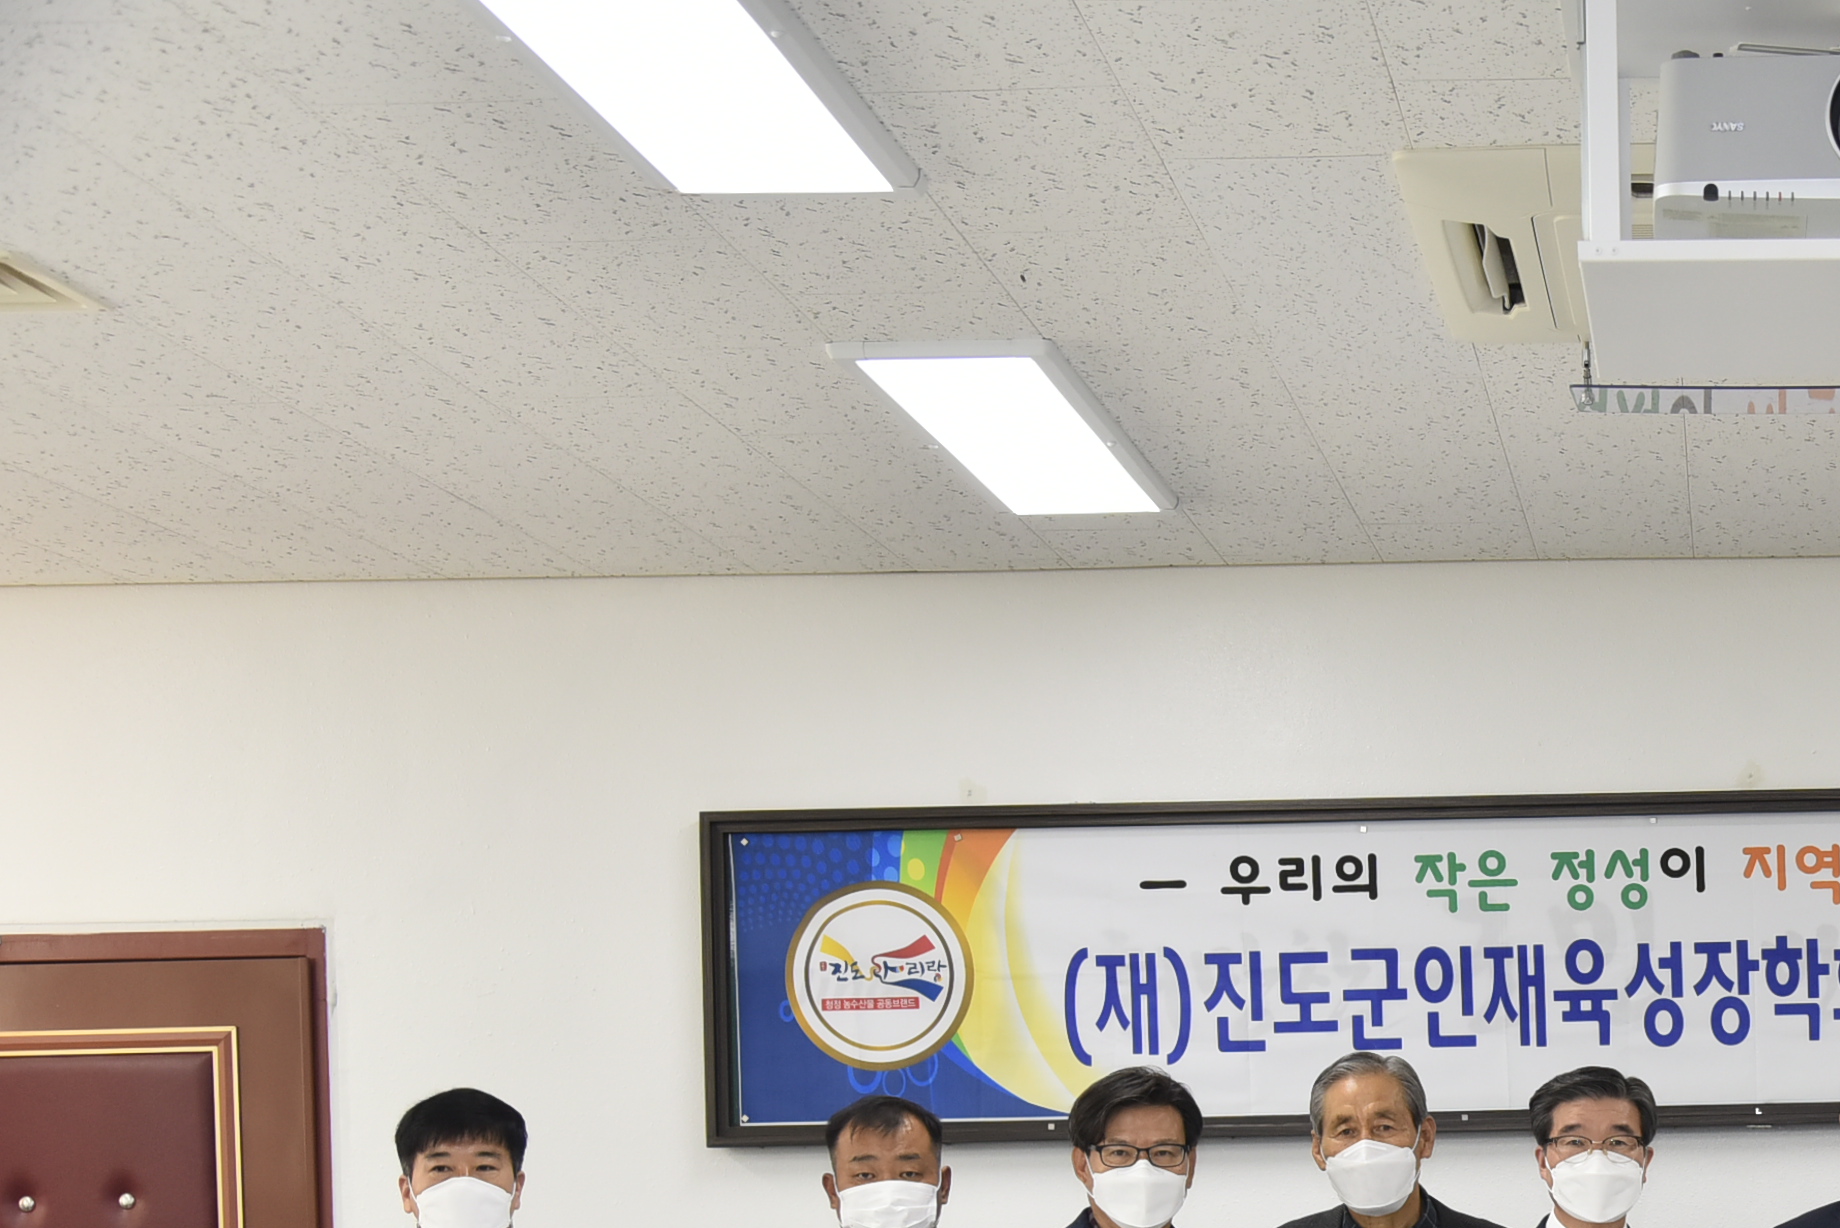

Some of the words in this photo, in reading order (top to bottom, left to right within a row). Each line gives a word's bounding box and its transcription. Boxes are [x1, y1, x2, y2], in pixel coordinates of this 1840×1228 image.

[1221, 853, 1378, 906] 우리의
[1414, 849, 1518, 913] 작은
[1551, 846, 1706, 911] 정성이
[1742, 843, 1840, 905] 지역
